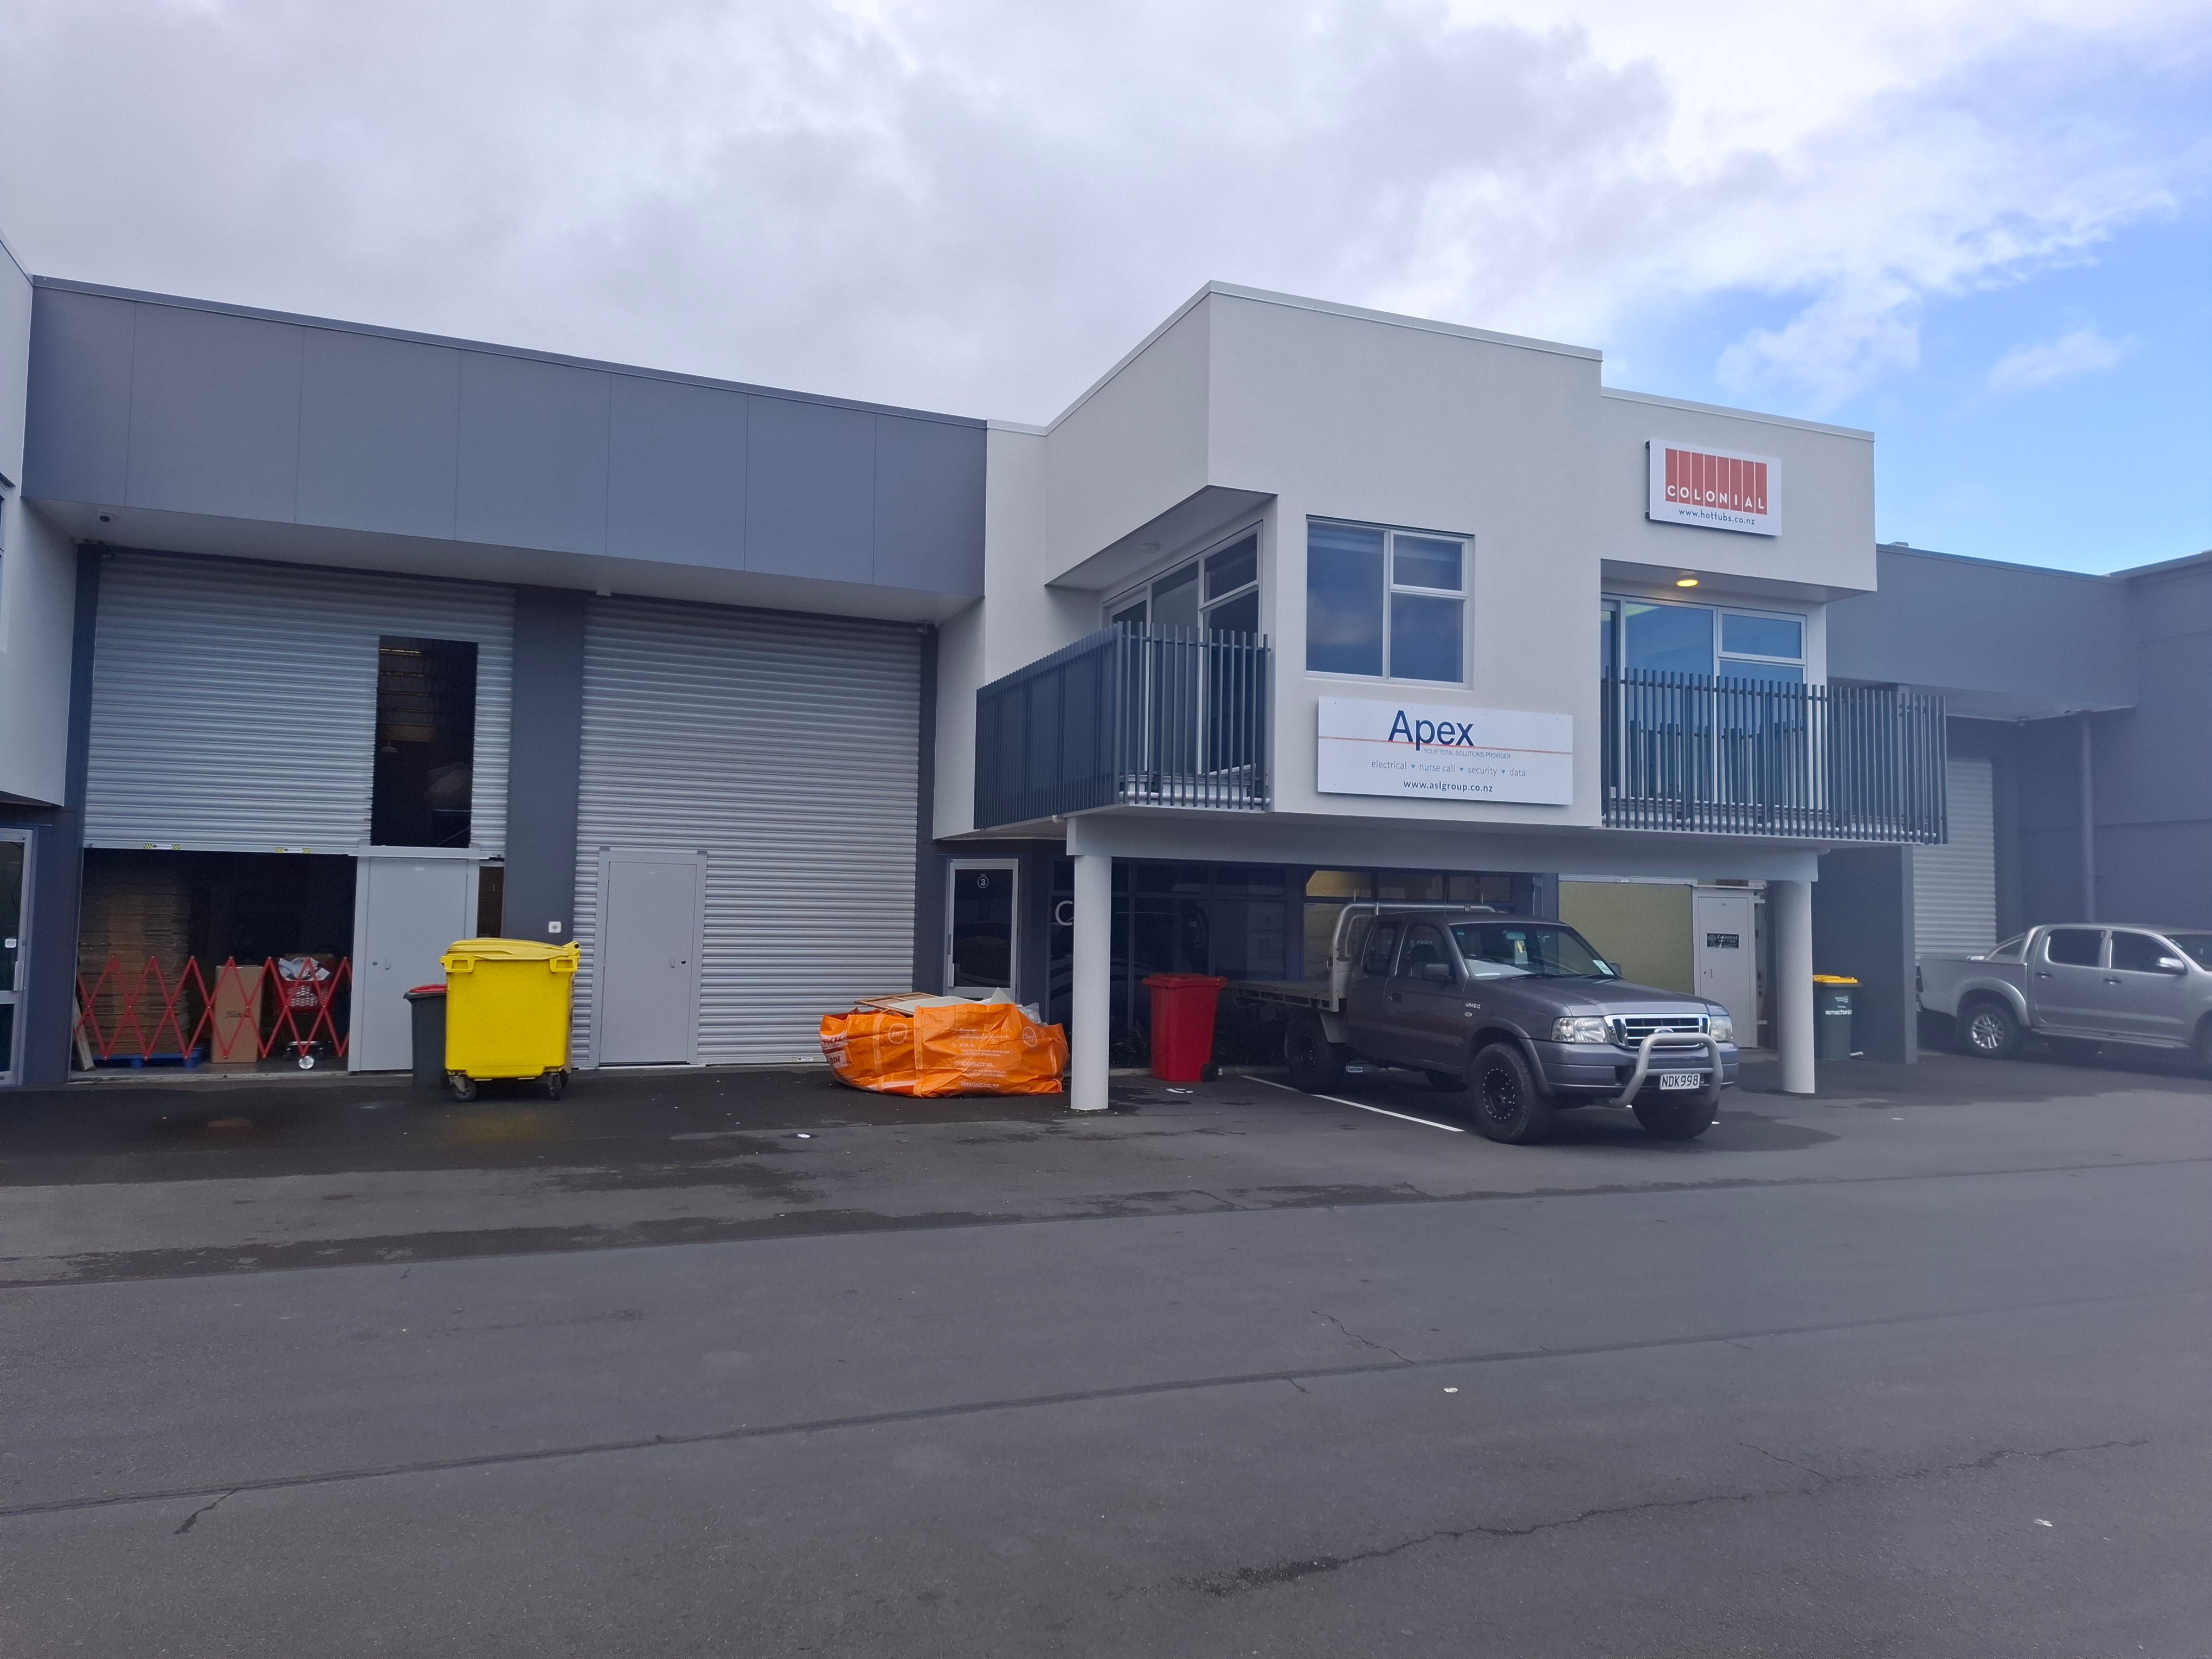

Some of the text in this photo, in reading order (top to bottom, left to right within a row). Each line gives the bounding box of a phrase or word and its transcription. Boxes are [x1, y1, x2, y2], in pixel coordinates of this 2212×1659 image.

[1667, 485, 1764, 509] COLONIAL
[1679, 509, 1756, 525] www.hottubs.co.nz
[1388, 710, 1475, 751] Apex
[1455, 750, 1484, 758] SOLUTIONS
[1371, 760, 1407, 770] electrical
[1442, 763, 1455, 773] call
[1468, 766, 1497, 776] security
[1509, 768, 1526, 777] data
[1403, 777, 1493, 793] www.aslgroup.co.nz
[1662, 1075, 1699, 1088] NDK998
